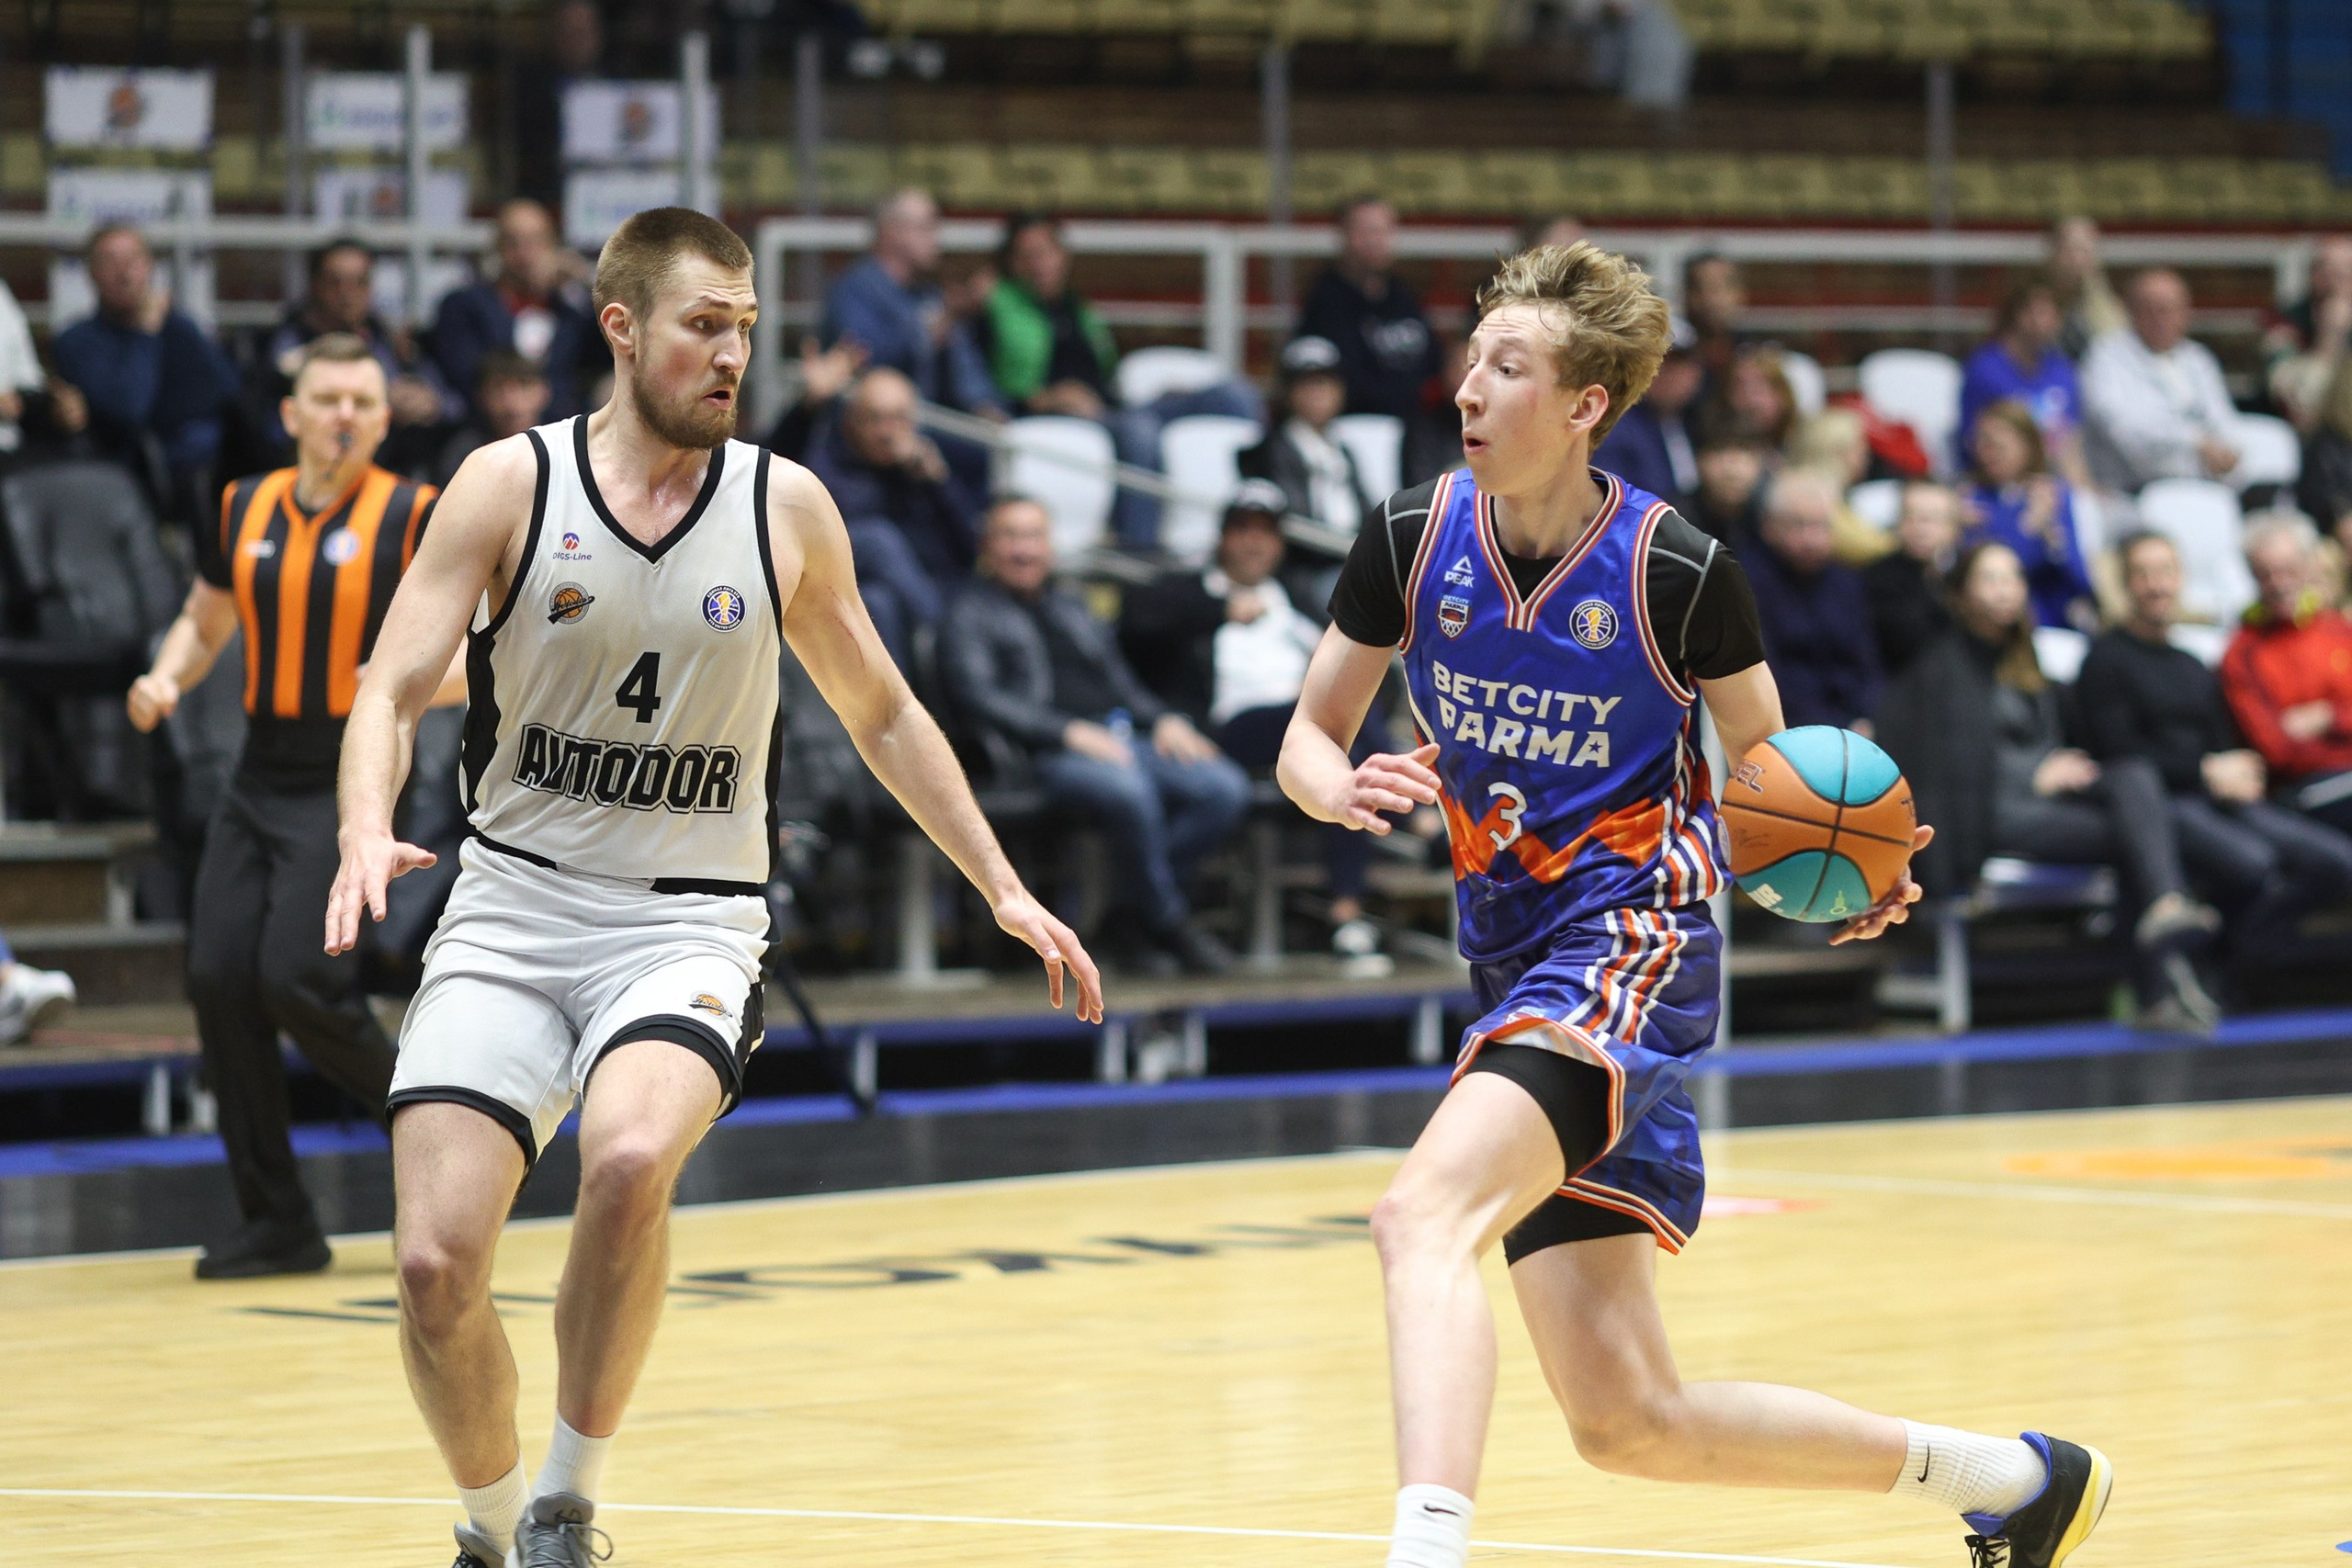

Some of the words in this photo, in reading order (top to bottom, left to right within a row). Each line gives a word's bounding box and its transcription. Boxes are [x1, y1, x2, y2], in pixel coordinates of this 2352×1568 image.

[1442, 594, 1470, 604] BETCITY
[1443, 570, 1476, 588] PEAK
[615, 651, 662, 724] 4
[1432, 660, 1623, 725] BETCITY
[1436, 694, 1611, 768] PARMA
[512, 723, 741, 814] AVTODOR
[1487, 782, 1528, 852] 3
